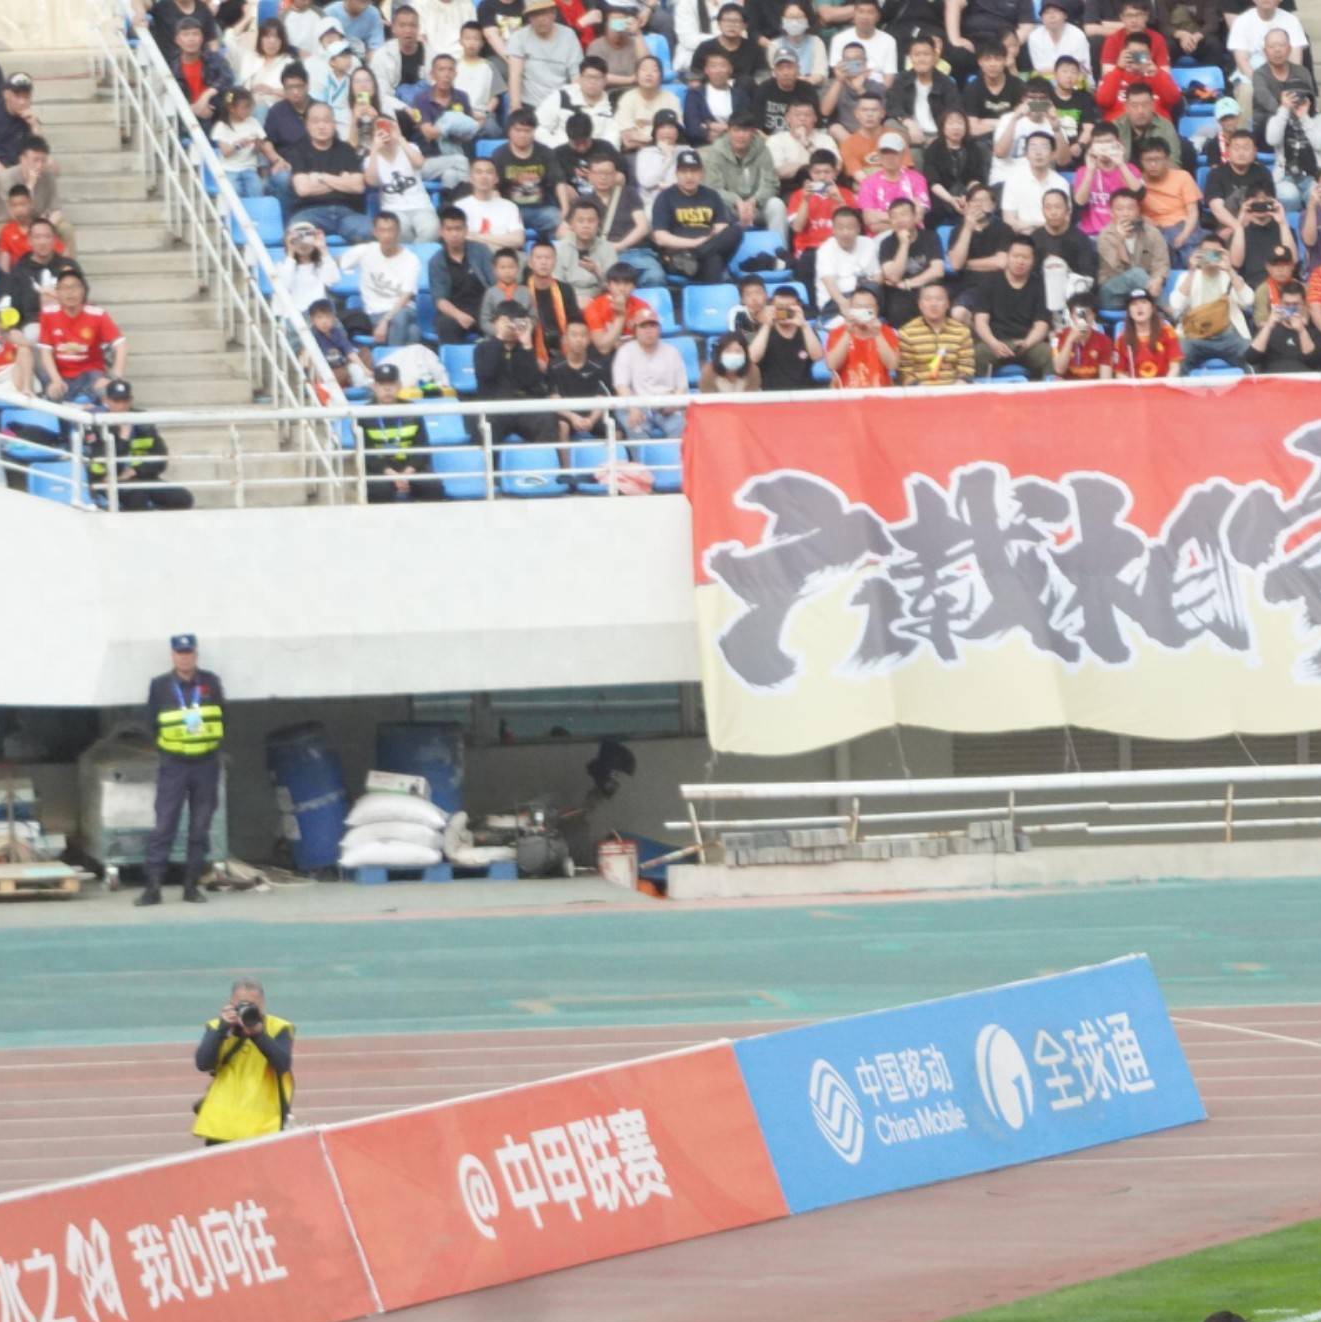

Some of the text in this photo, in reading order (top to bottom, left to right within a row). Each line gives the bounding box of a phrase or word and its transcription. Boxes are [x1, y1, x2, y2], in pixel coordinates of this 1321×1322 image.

[854, 1043, 953, 1107] 中国移动
[1033, 1012, 1155, 1112] 全球通
[875, 1100, 969, 1146] China Mobile
[457, 1107, 673, 1241] @中甲联赛
[127, 1199, 290, 1310] 我心向往
